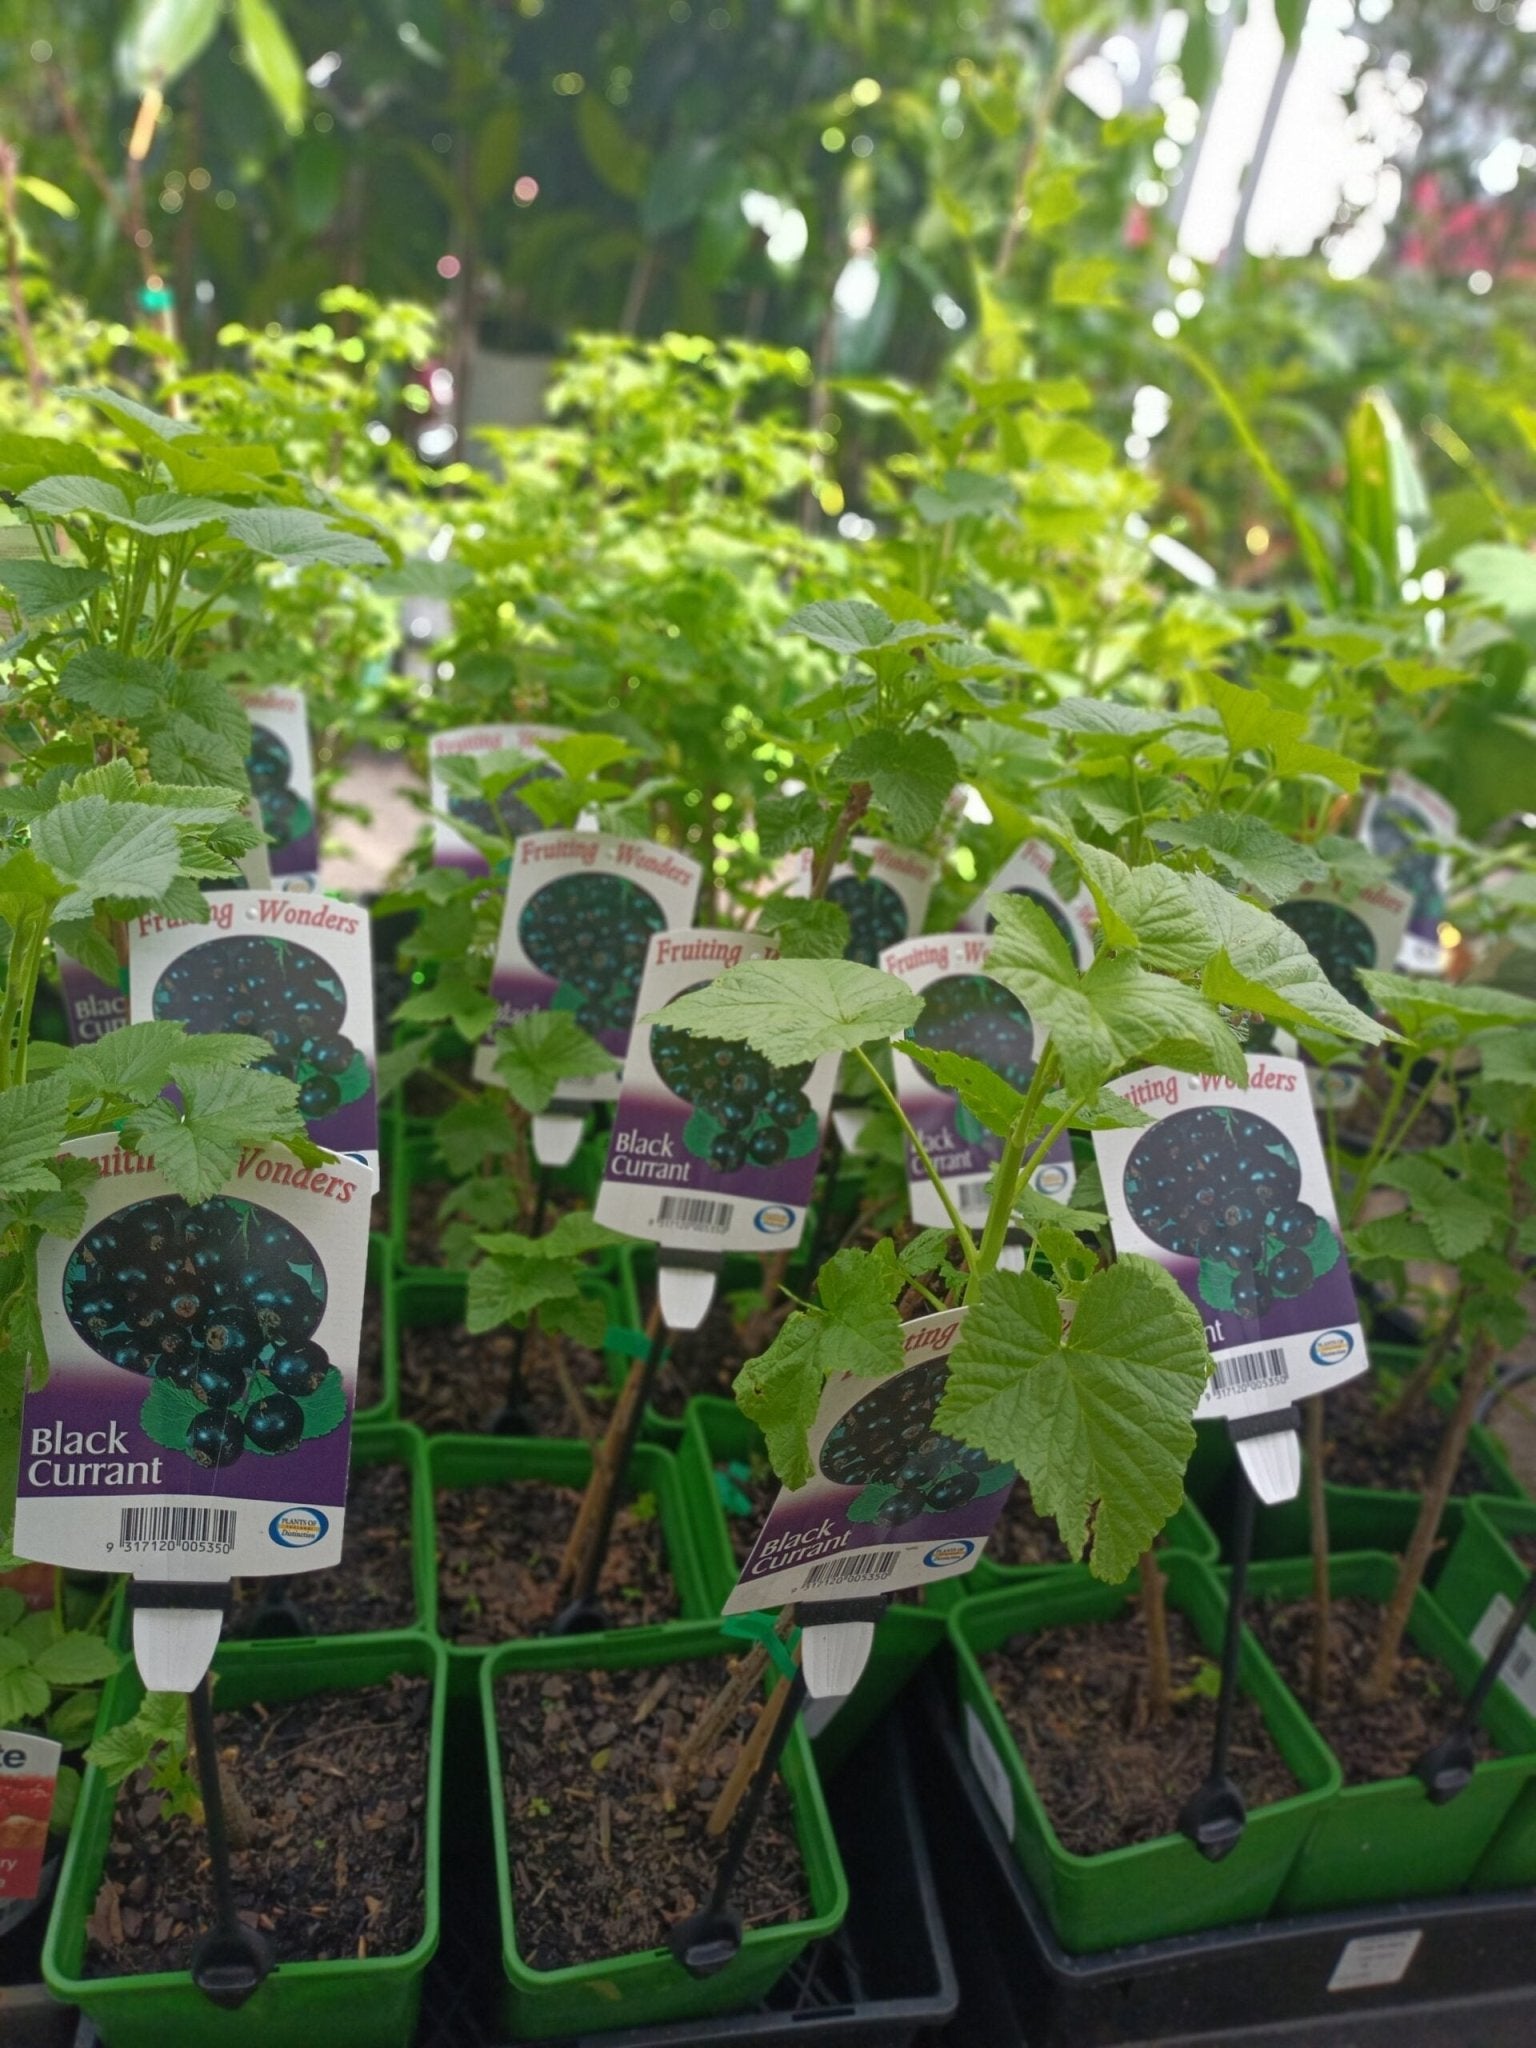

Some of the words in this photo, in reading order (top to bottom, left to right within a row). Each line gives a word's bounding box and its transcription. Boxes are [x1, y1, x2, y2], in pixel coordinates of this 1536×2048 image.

[521, 839, 599, 865] Fruiting
[258, 899, 359, 935] Wonders
[656, 939, 743, 968] Fruiting
[75, 994, 126, 1020] Blac
[615, 1129, 675, 1158] Black
[611, 1155, 692, 1182] Currant
[31, 1420, 130, 1455] Black
[28, 1457, 163, 1487] Currant
[106, 1542, 114, 1553] 9
[124, 1540, 176, 1552] 317120
[181, 1540, 230, 1554] 005350
[751, 1530, 852, 1575] Currant
[759, 1518, 836, 1558] Black
